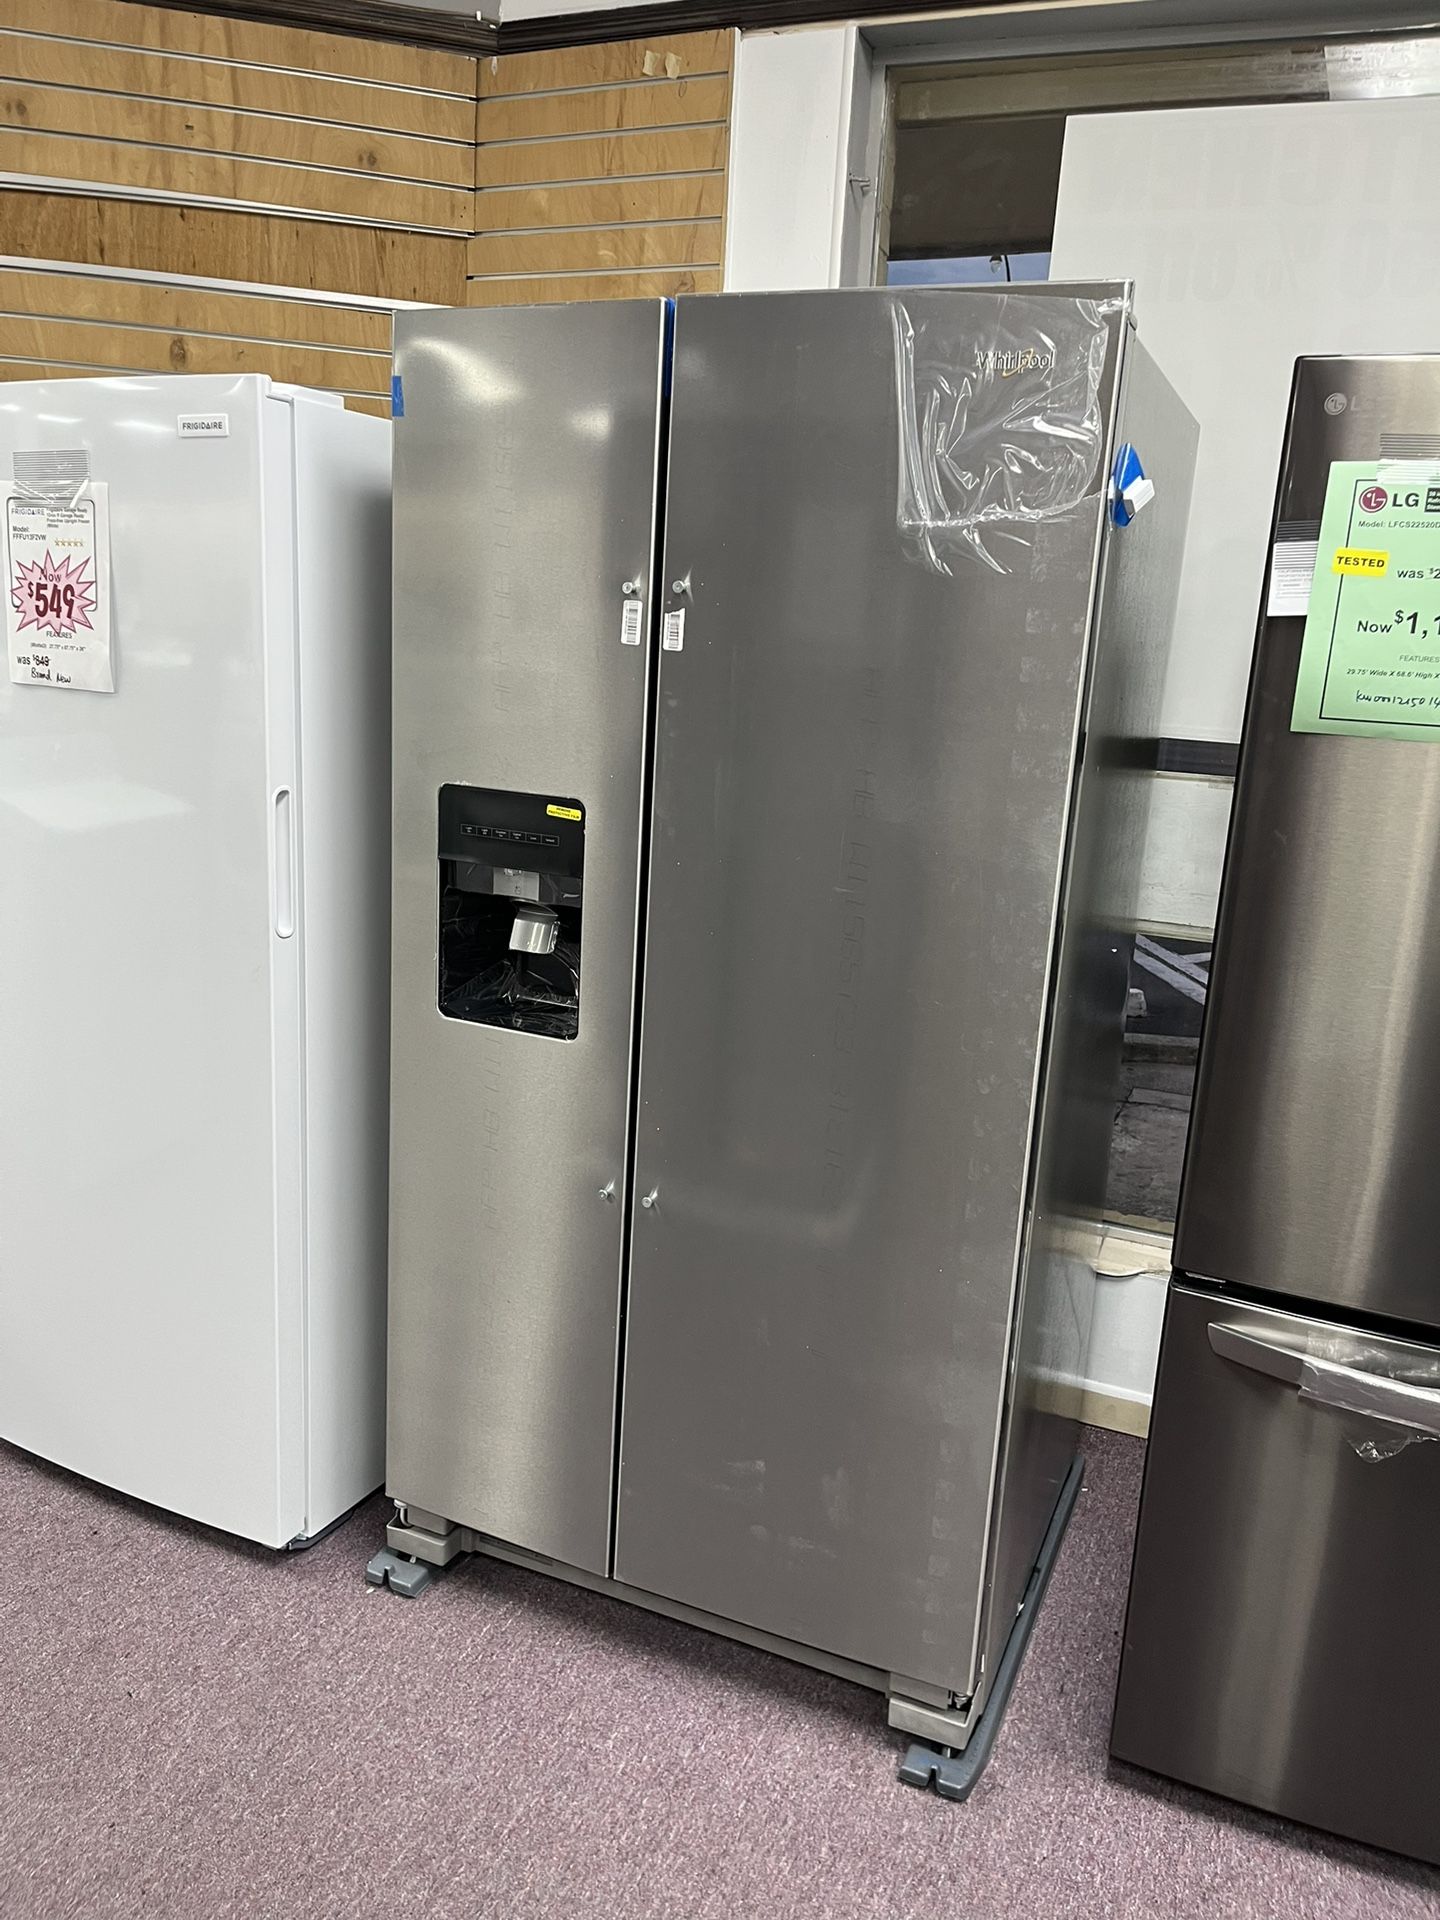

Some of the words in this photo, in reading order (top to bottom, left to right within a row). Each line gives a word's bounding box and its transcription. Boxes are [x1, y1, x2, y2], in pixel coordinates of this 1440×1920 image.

[976, 350, 1055, 374] Whirlpool
[182, 421, 223, 430] FRIGIDAIRE
[1392, 492, 1419, 508] LG
[13, 525, 30, 533] Model:
[1337, 556, 1385, 568] TESTED
[1397, 570, 1424, 579] was
[28, 581, 75, 619] $549
[1357, 620, 1393, 633] Now
[17, 656, 31, 665] was
[1400, 655, 1440, 663] FEATURES
[1415, 672, 1432, 680] High
